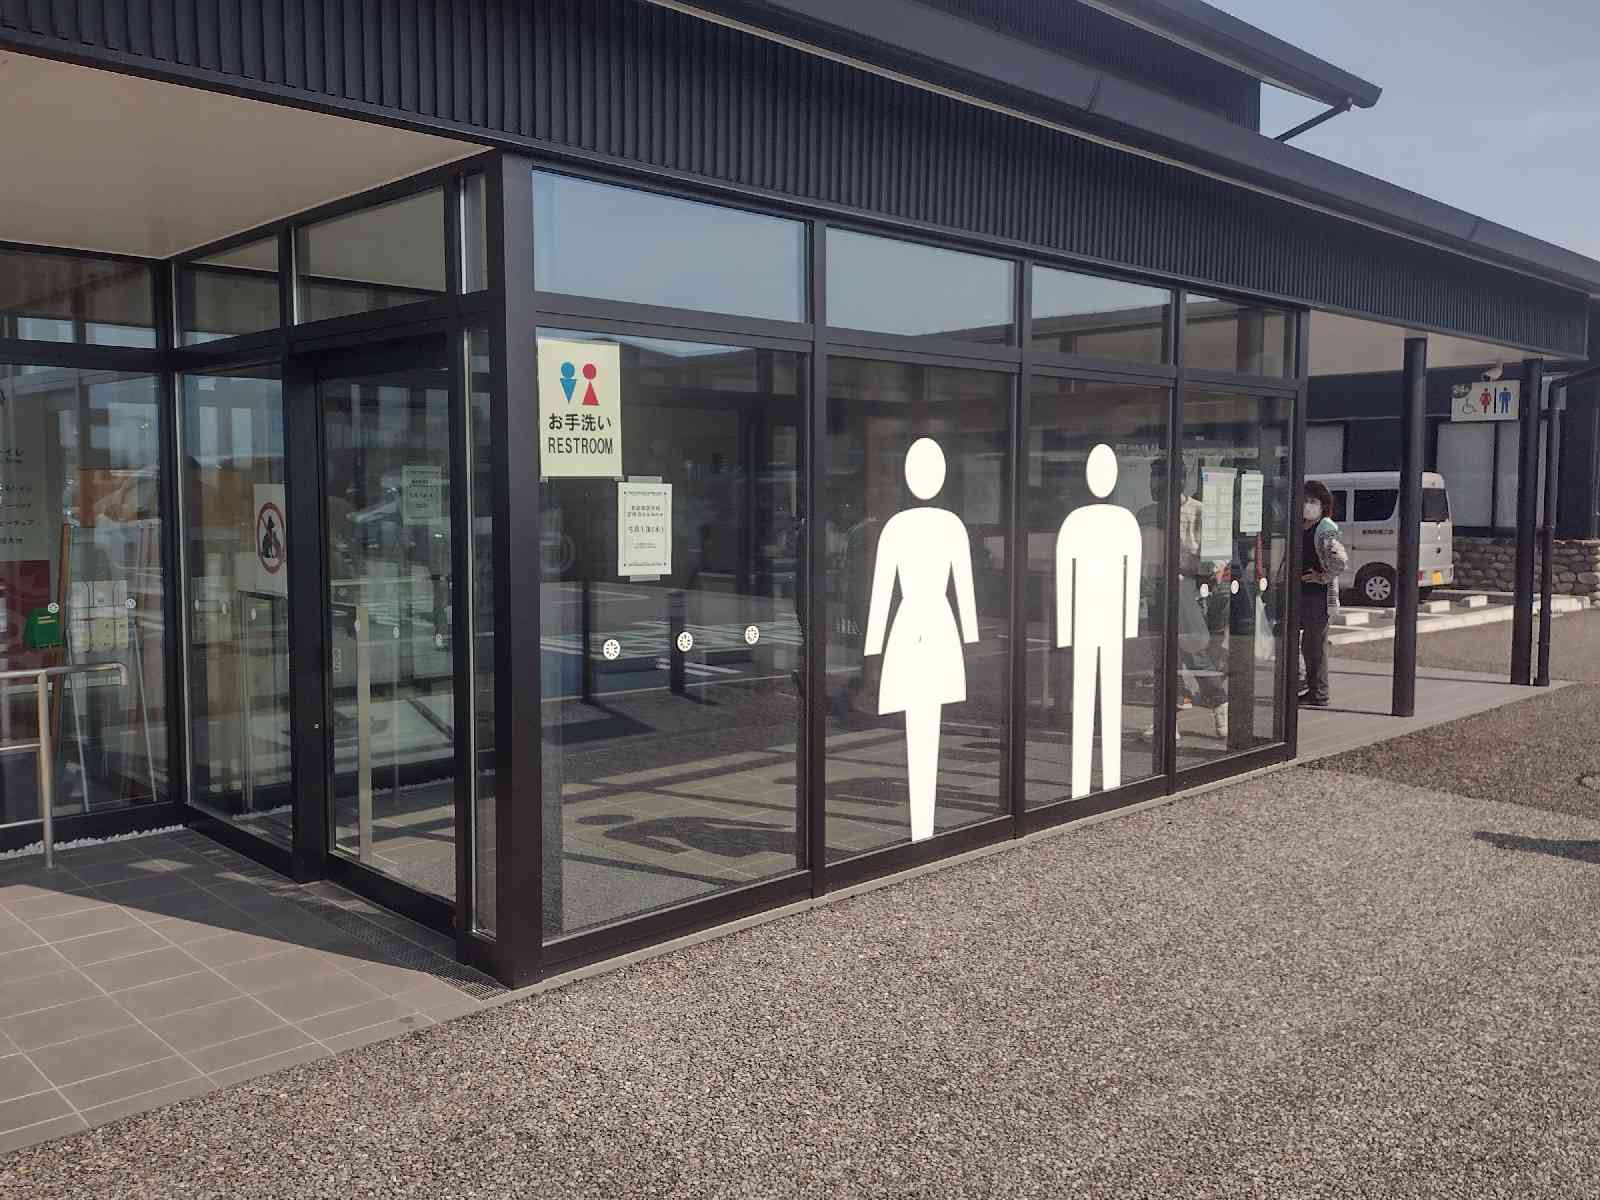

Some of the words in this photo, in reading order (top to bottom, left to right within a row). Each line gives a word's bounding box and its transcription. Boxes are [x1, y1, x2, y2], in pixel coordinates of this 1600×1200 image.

[548, 413, 612, 431] お手洗い
[548, 437, 613, 454] RESTROOM
